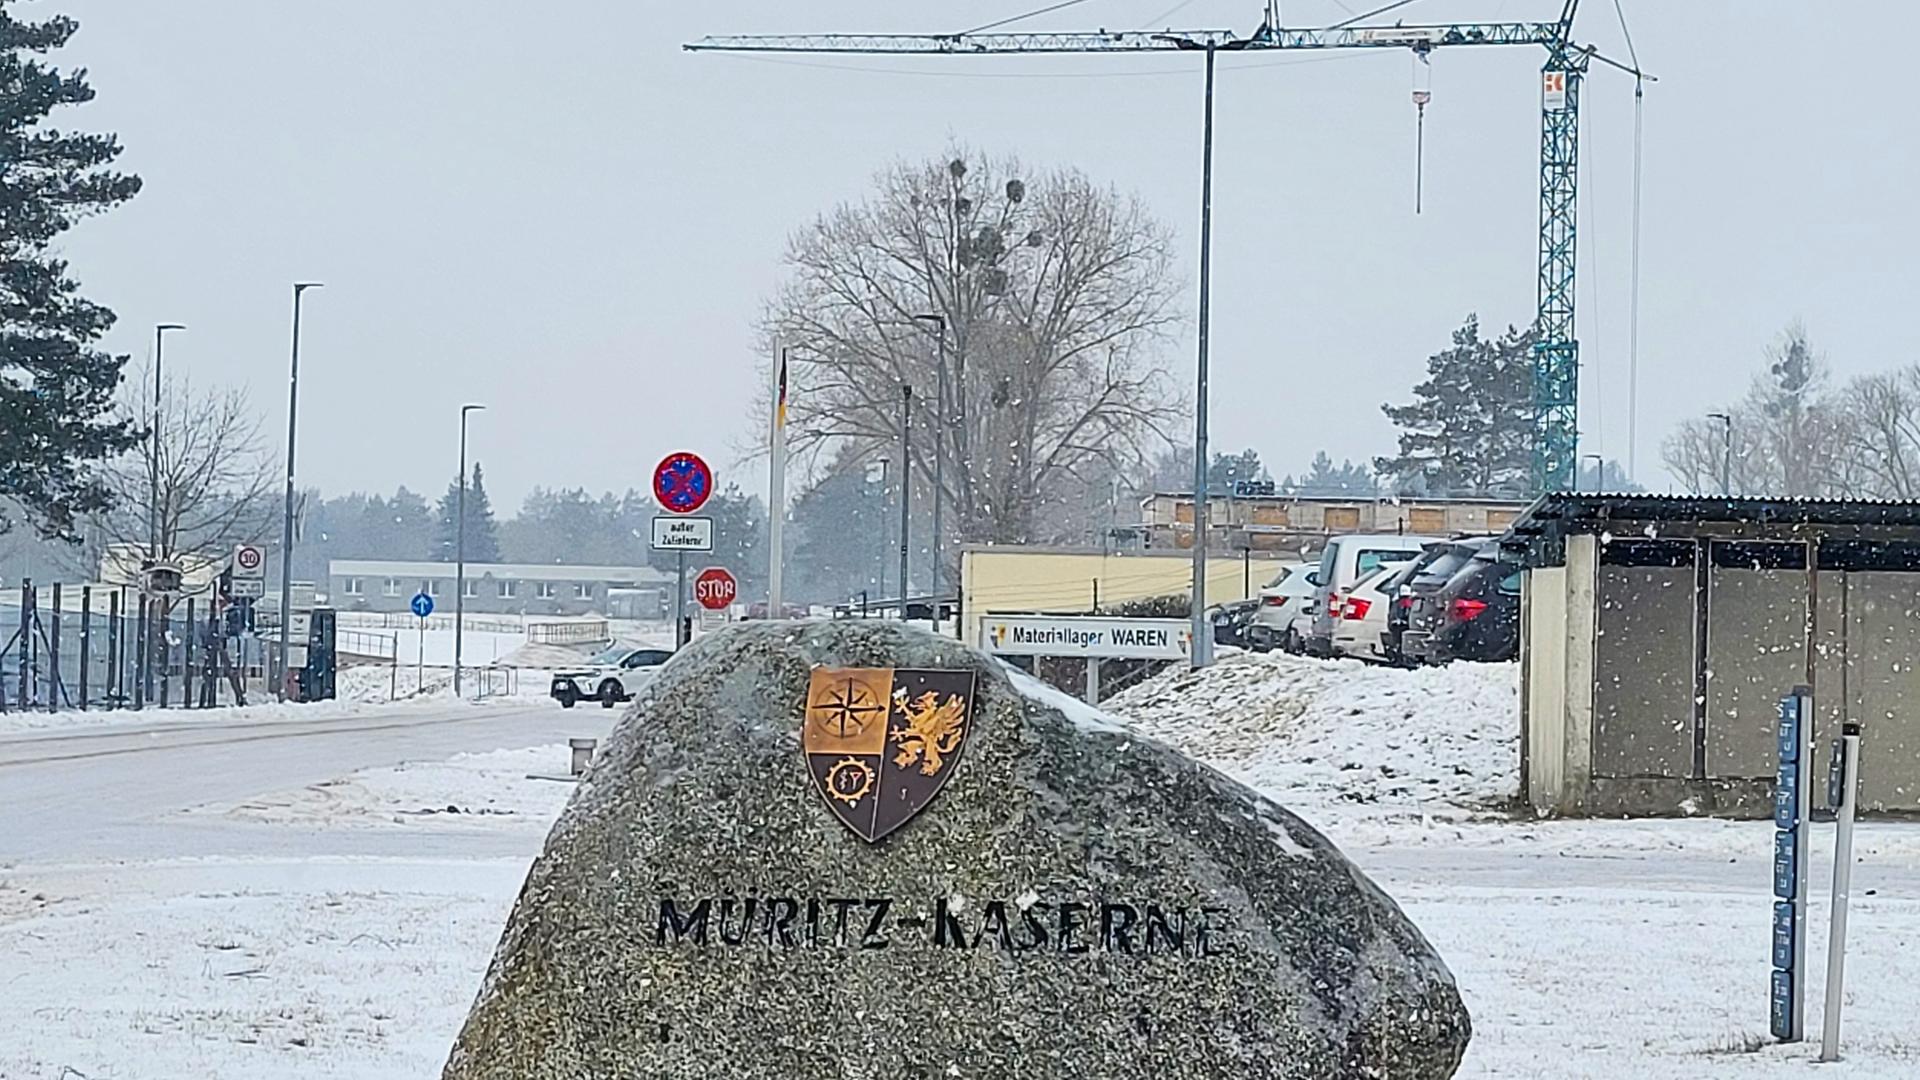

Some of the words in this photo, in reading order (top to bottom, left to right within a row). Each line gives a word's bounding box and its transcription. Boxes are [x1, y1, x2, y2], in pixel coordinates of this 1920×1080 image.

[698, 579, 734, 599] STOP
[1013, 627, 1104, 648] Materiallager
[1111, 628, 1169, 647] WAREN
